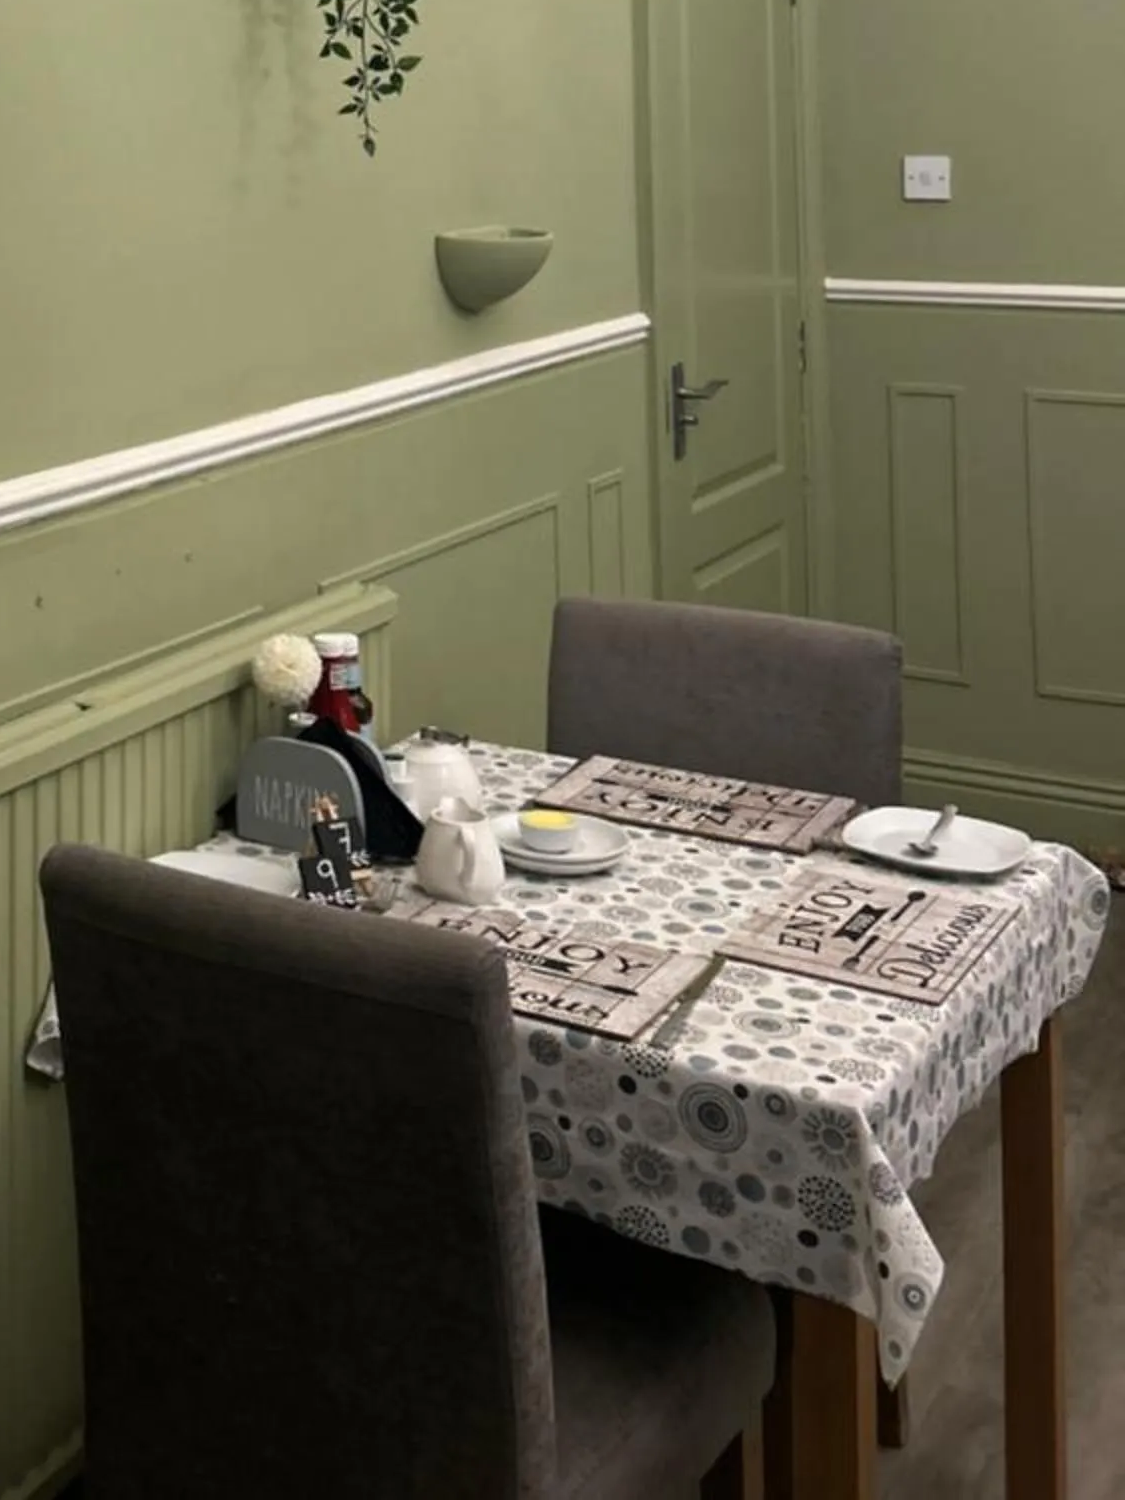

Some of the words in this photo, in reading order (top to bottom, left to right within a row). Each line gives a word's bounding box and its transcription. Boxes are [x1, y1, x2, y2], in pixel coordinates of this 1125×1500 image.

[328, 821, 351, 854] 7
[316, 858, 339, 889] 9
[778, 879, 873, 954] ENJOY
[876, 903, 992, 988] Delicious
[437, 917, 652, 975] ENJOY
